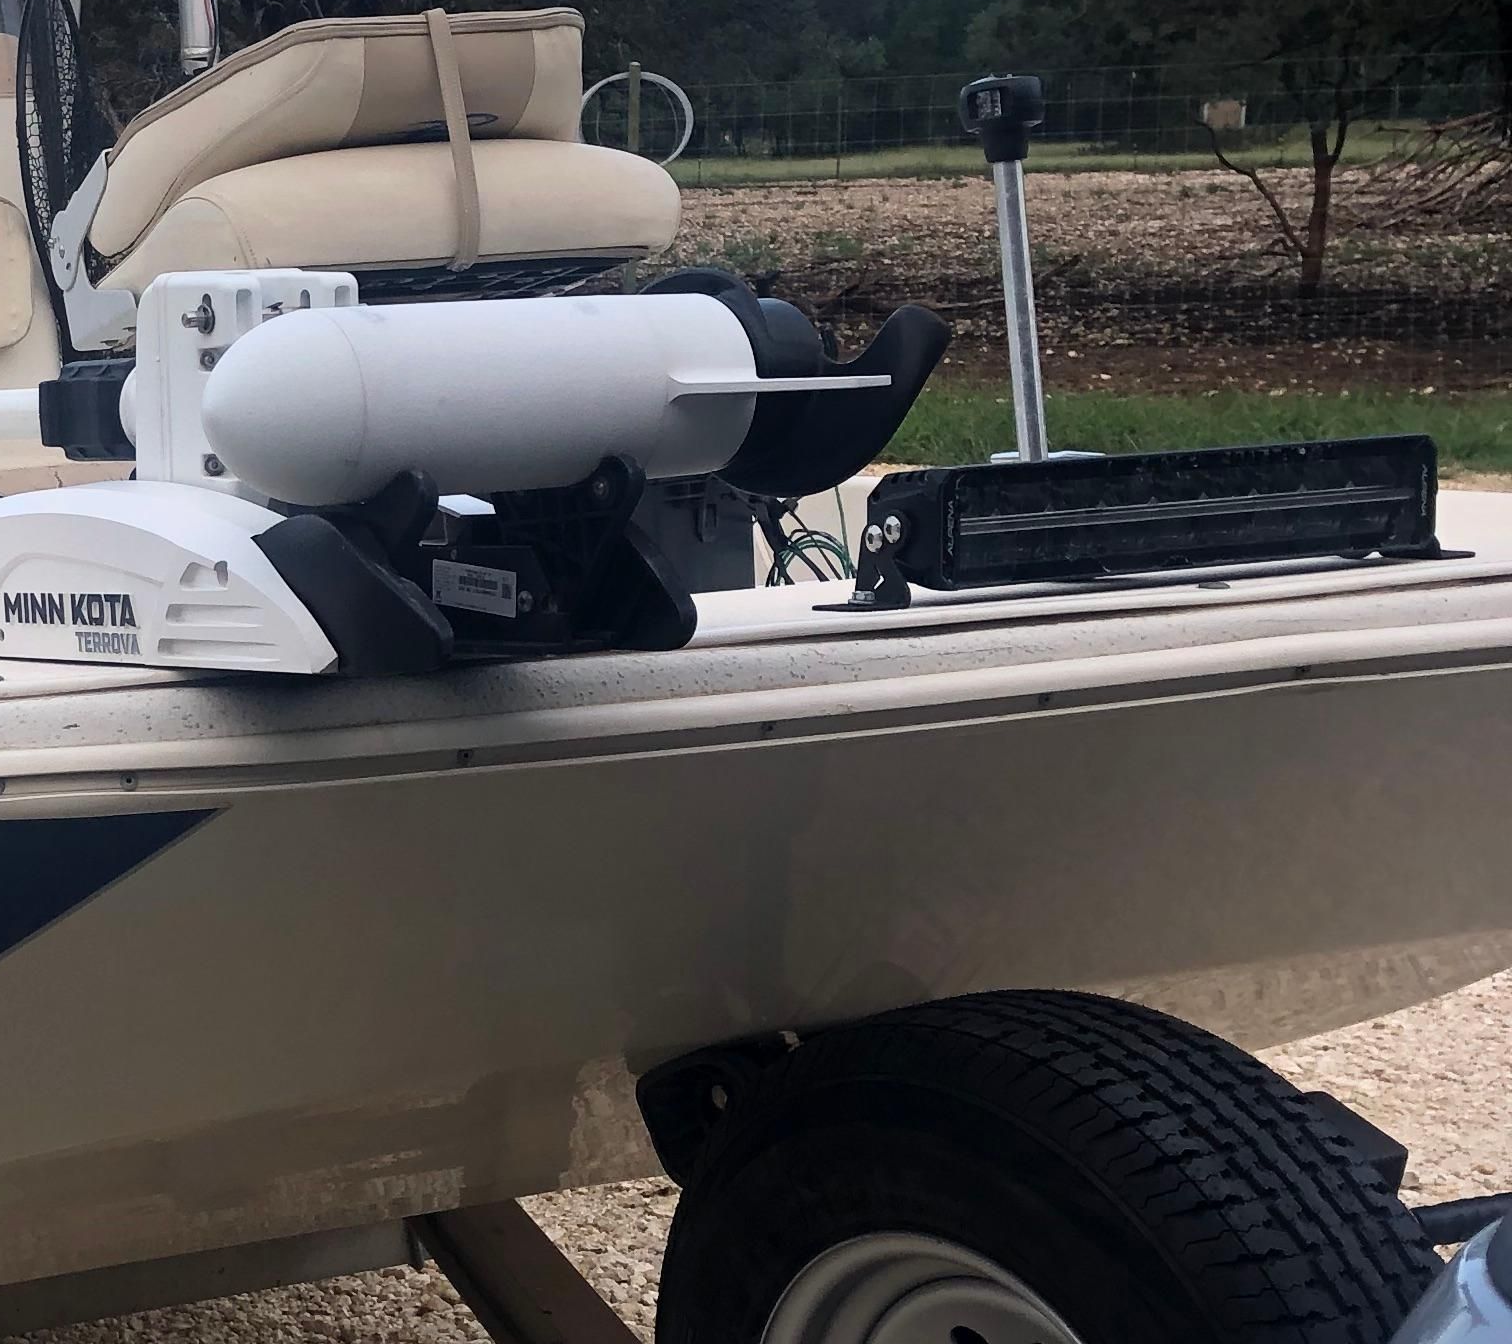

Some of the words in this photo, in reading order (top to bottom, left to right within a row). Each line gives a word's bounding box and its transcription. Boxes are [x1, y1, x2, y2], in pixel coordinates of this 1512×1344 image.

[3, 592, 66, 625] MINN
[70, 593, 138, 628] KOTA
[75, 631, 142, 655] TERROVA
